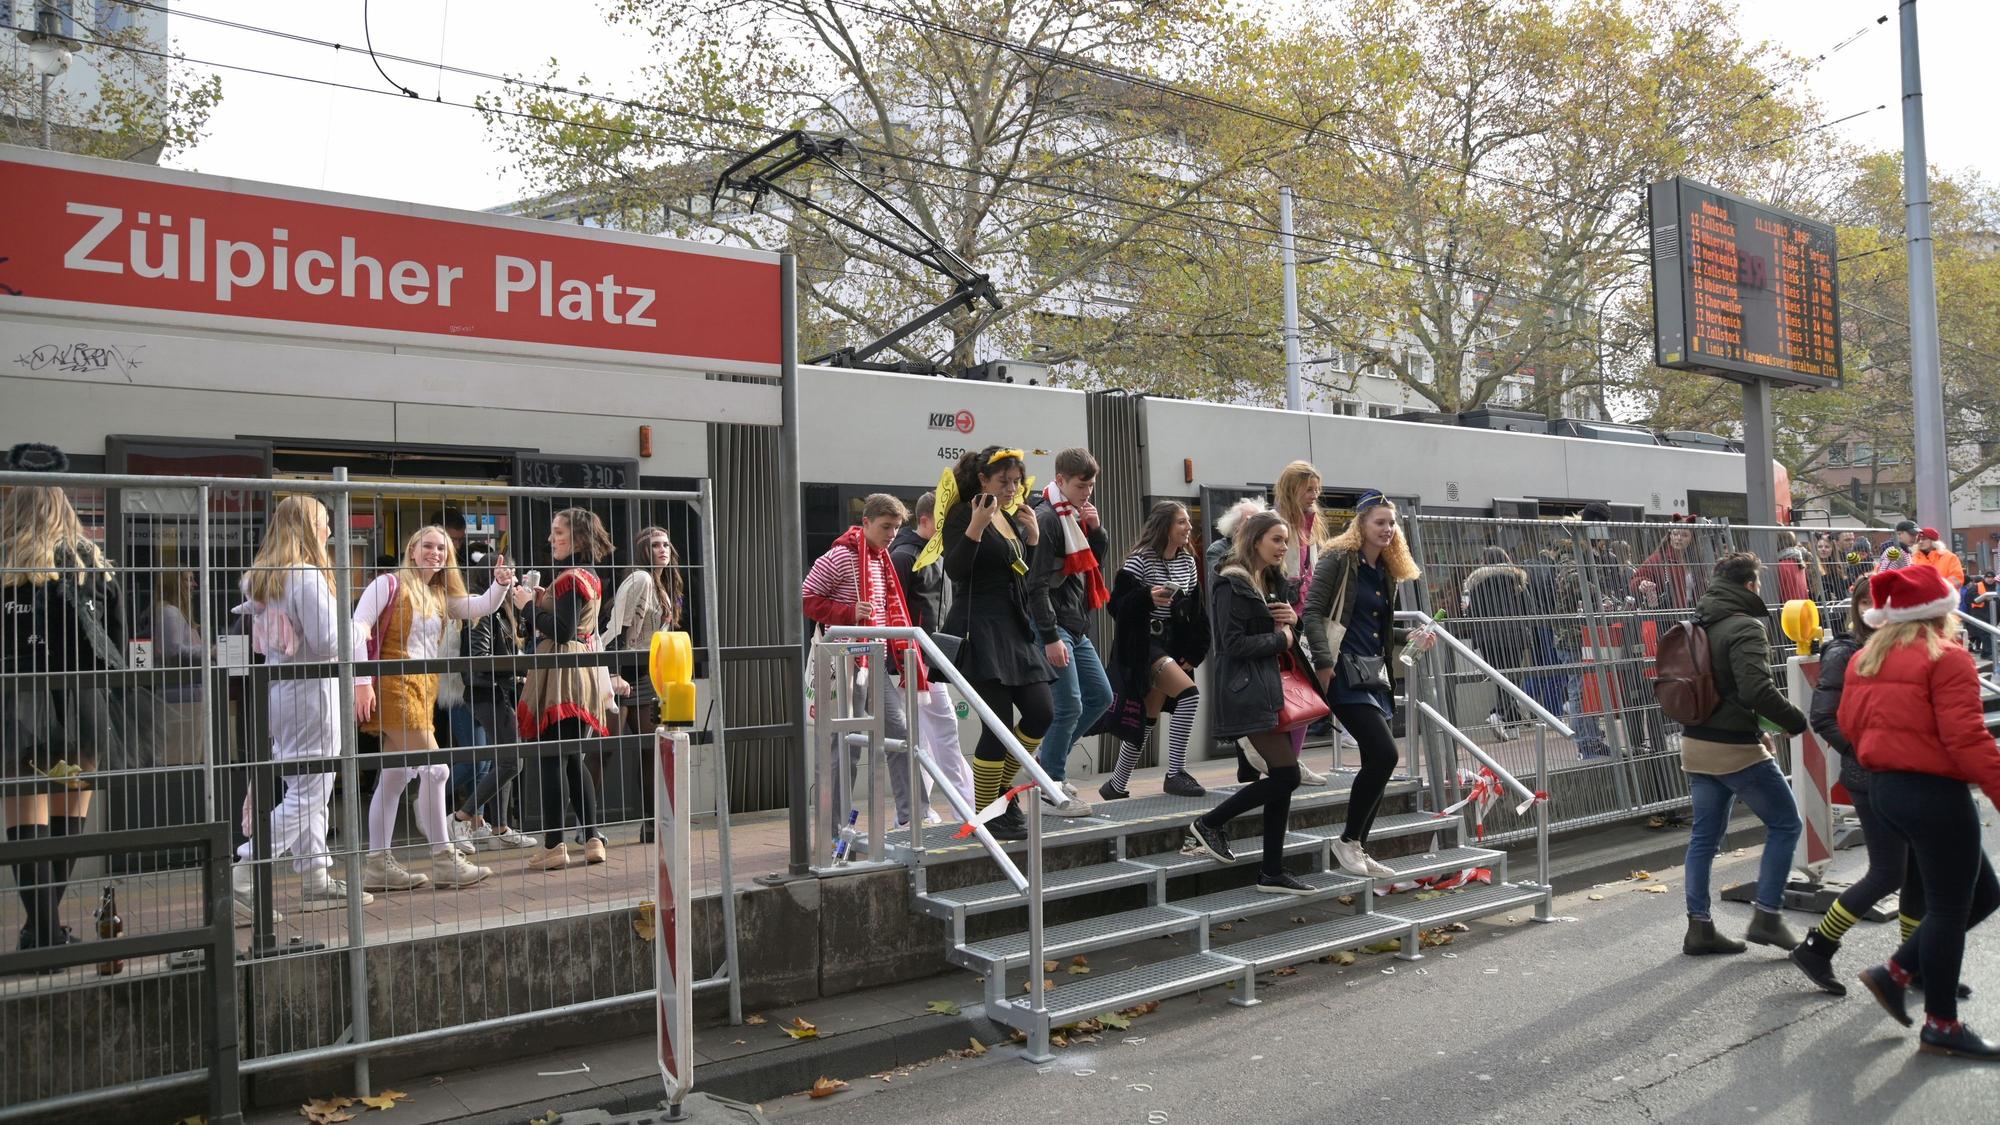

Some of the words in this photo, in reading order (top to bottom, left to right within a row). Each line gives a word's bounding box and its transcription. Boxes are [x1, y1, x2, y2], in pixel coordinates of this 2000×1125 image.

[1702, 200, 1728, 221] Montag
[1690, 211, 1699, 226] 12
[1701, 215, 1735, 236] Zollstock
[1782, 240, 1798, 255] Gleis
[1691, 228, 1700, 243] 15
[1701, 232, 1735, 254] Ubierring
[1782, 255, 1798, 270] Gleis
[1820, 265, 1830, 278] Min
[64, 202, 463, 307] Zülpicher
[494, 255, 658, 329] Platz
[1692, 244, 1701, 259] 12
[1702, 248, 1737, 268] Merkenich
[1783, 270, 1799, 284] Gleis
[1821, 279, 1831, 292] Min
[1693, 260, 1701, 274] 12
[1703, 263, 1736, 283] Zollstock
[1784, 285, 1800, 299] Gleis
[1821, 294, 1831, 306] Min
[1693, 275, 1702, 290] 15
[1704, 279, 1737, 300] Ubierring
[1784, 299, 1800, 314] Gleis
[1812, 305, 1819, 318] 17
[1822, 308, 1832, 320] Min
[1694, 291, 1703, 306] 15
[1705, 295, 1742, 315] Chorweiler
[1785, 314, 1801, 328] Gleis
[1823, 322, 1832, 334] Min
[1695, 307, 1703, 322] 12
[1705, 311, 1741, 330] Merkenich
[1785, 328, 1802, 343] Gleis
[1823, 336, 1833, 349] Min
[1695, 323, 1704, 337] 12
[1706, 326, 1740, 345] Zollstock
[1786, 343, 1802, 357] Gleis
[1824, 350, 1834, 363] Min
[1705, 341, 1723, 356] Linie
[929, 413, 955, 428] KVB
